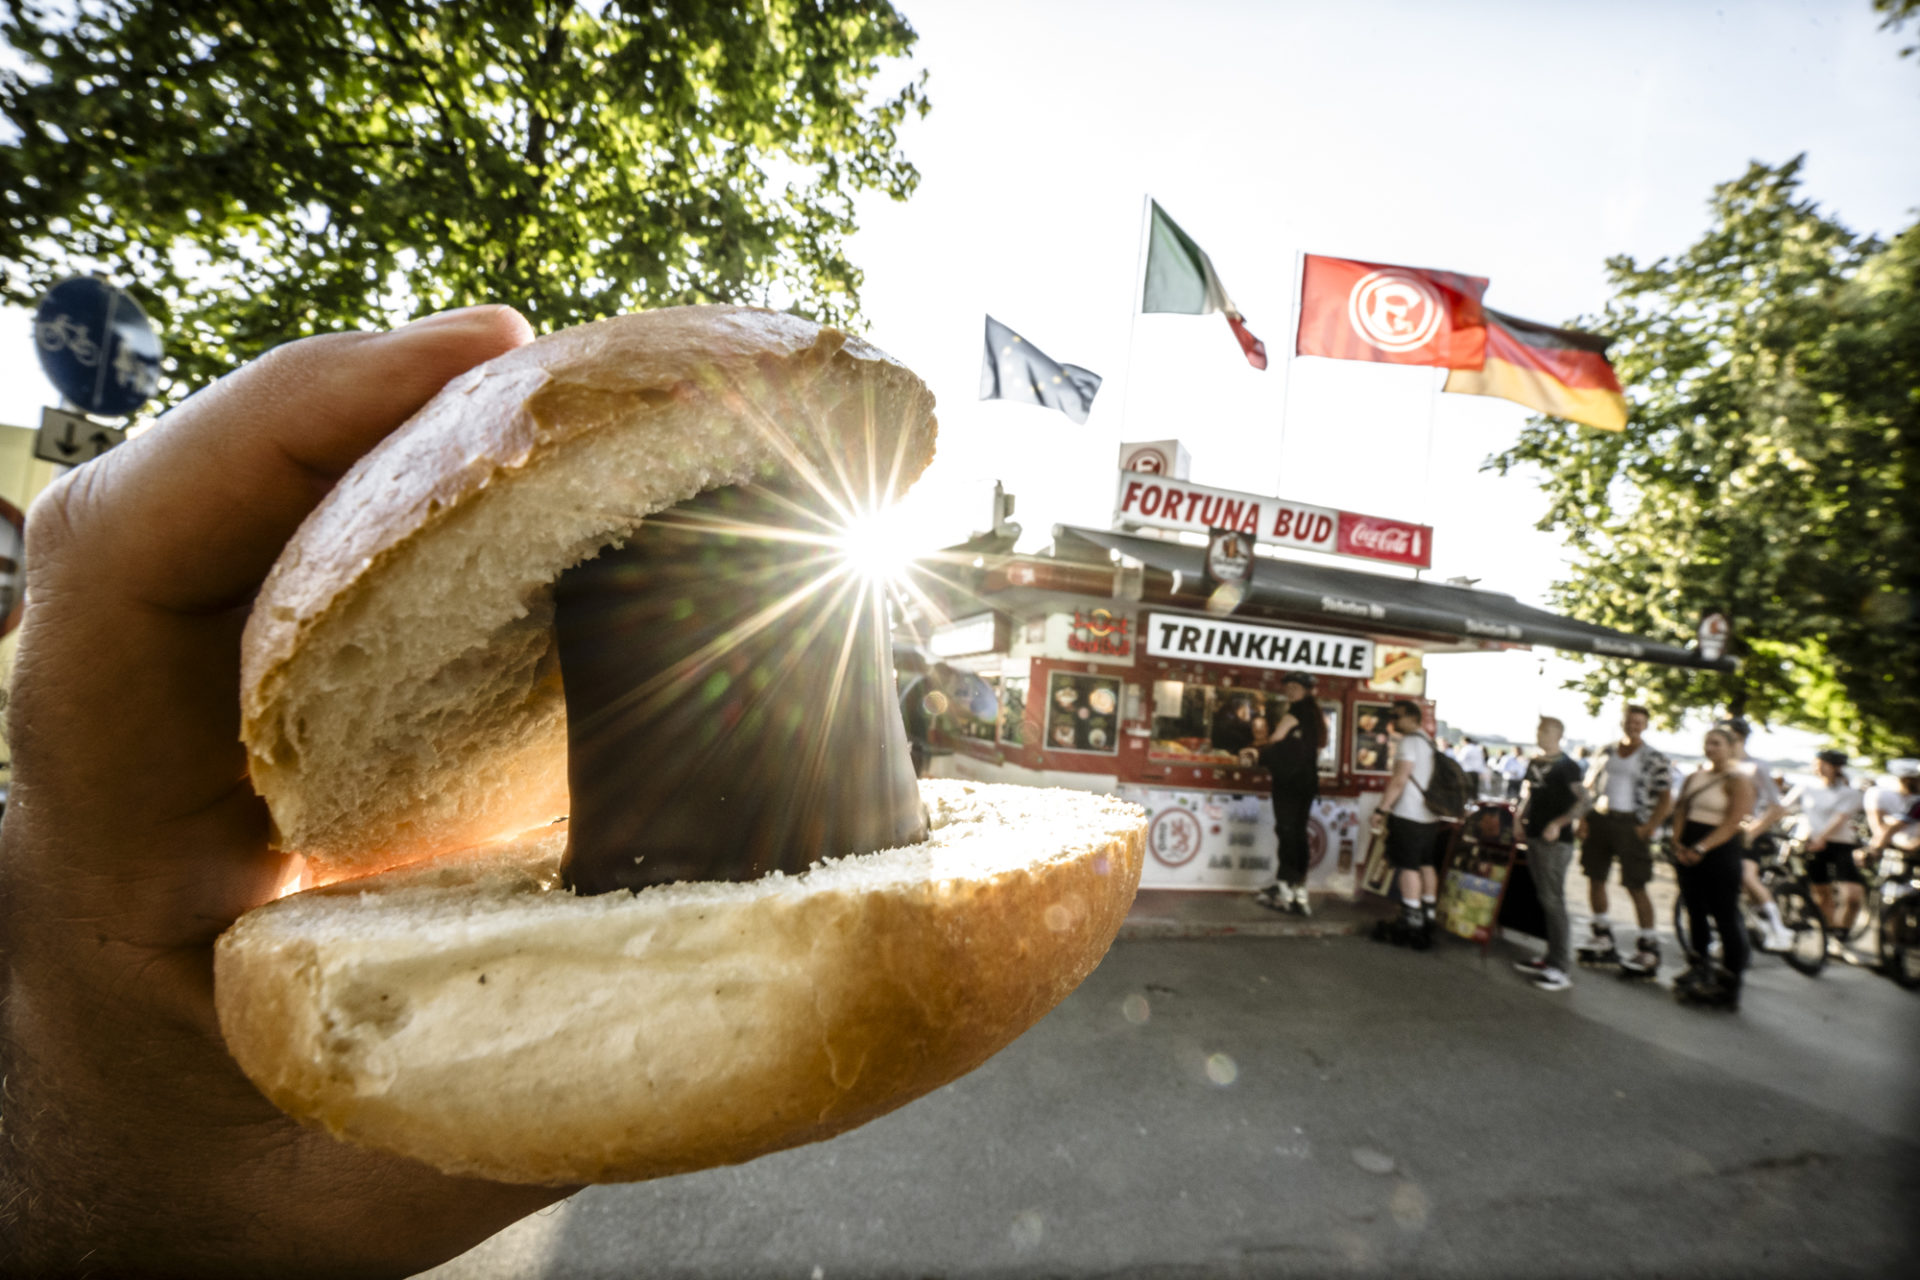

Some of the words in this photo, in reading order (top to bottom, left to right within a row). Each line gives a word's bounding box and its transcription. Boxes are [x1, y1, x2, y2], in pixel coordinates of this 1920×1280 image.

[1122, 482, 1259, 533] FORTUNA
[1272, 508, 1333, 544] BUD
[1159, 622, 1366, 671] TRINKHALLE
